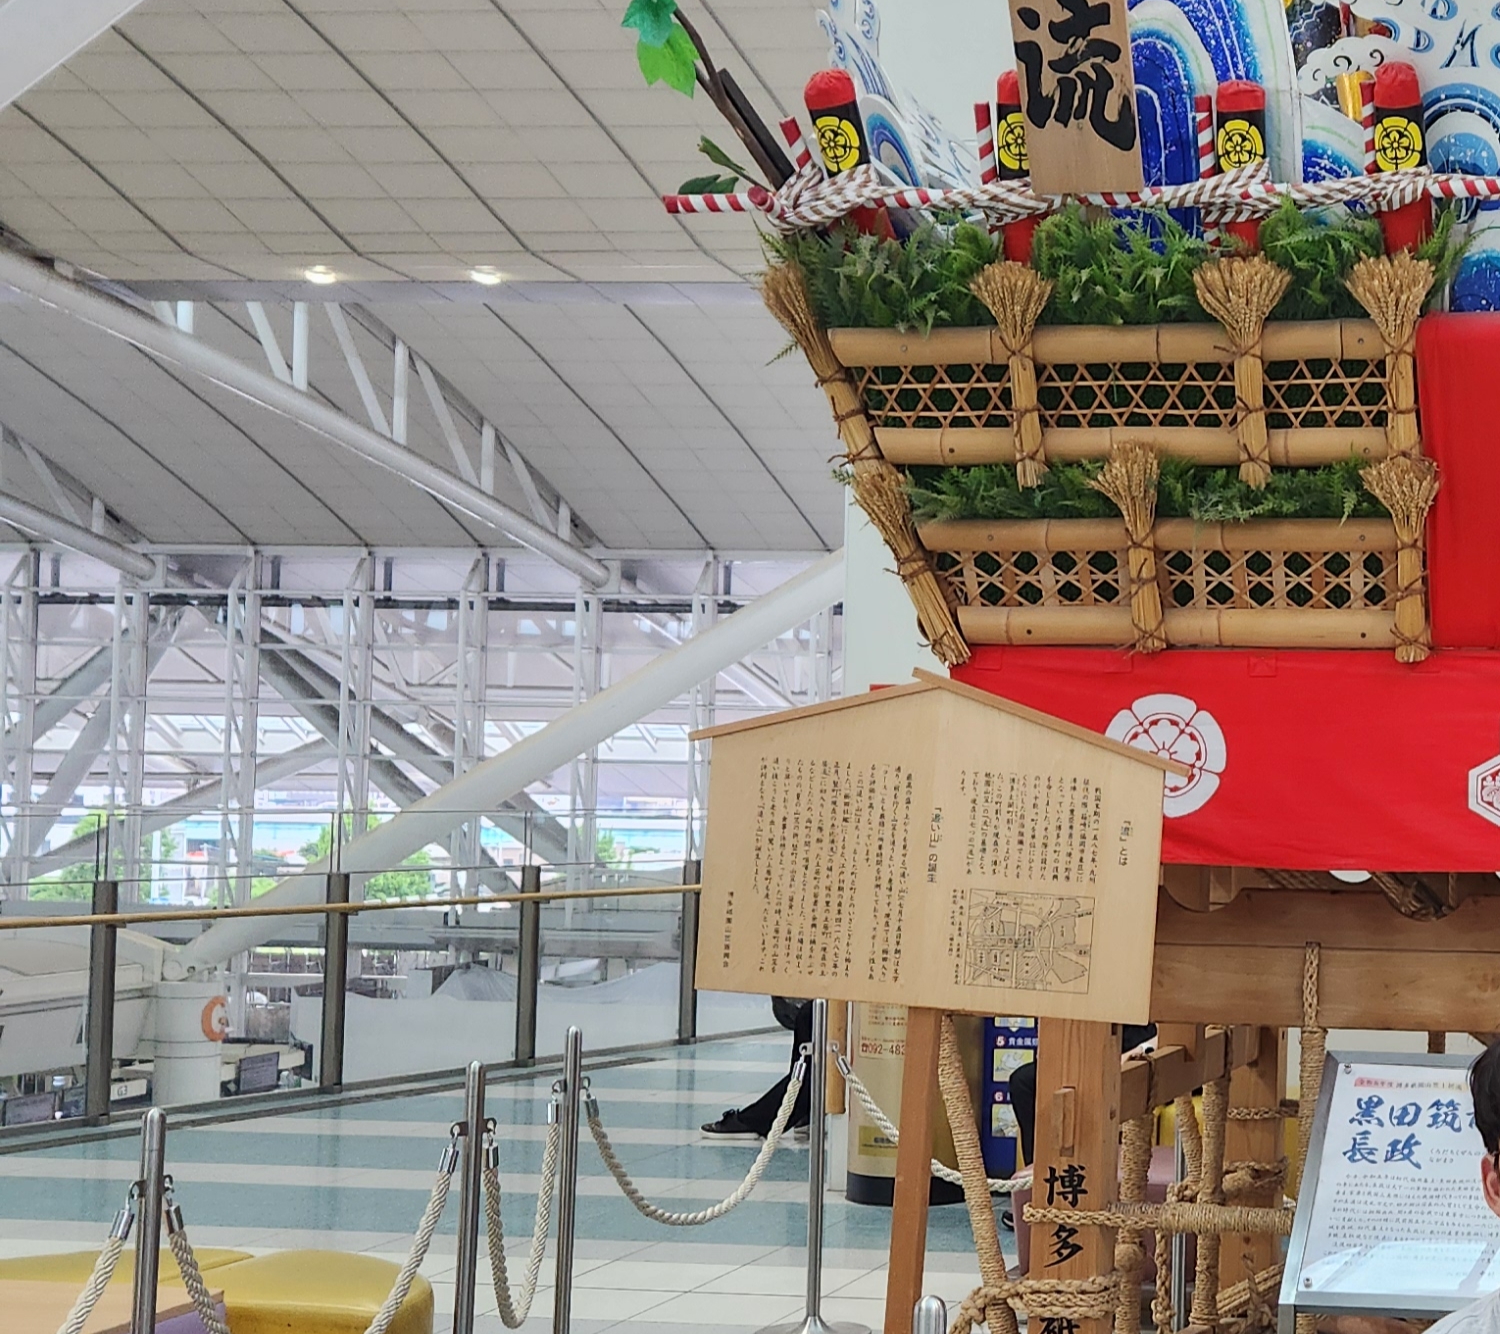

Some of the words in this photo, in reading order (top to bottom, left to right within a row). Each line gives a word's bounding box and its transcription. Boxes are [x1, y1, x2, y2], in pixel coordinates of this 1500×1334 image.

[996, 1035, 1005, 1046] 5
[994, 1091, 1003, 1101] 6
[1342, 1130, 1423, 1170] 長政
